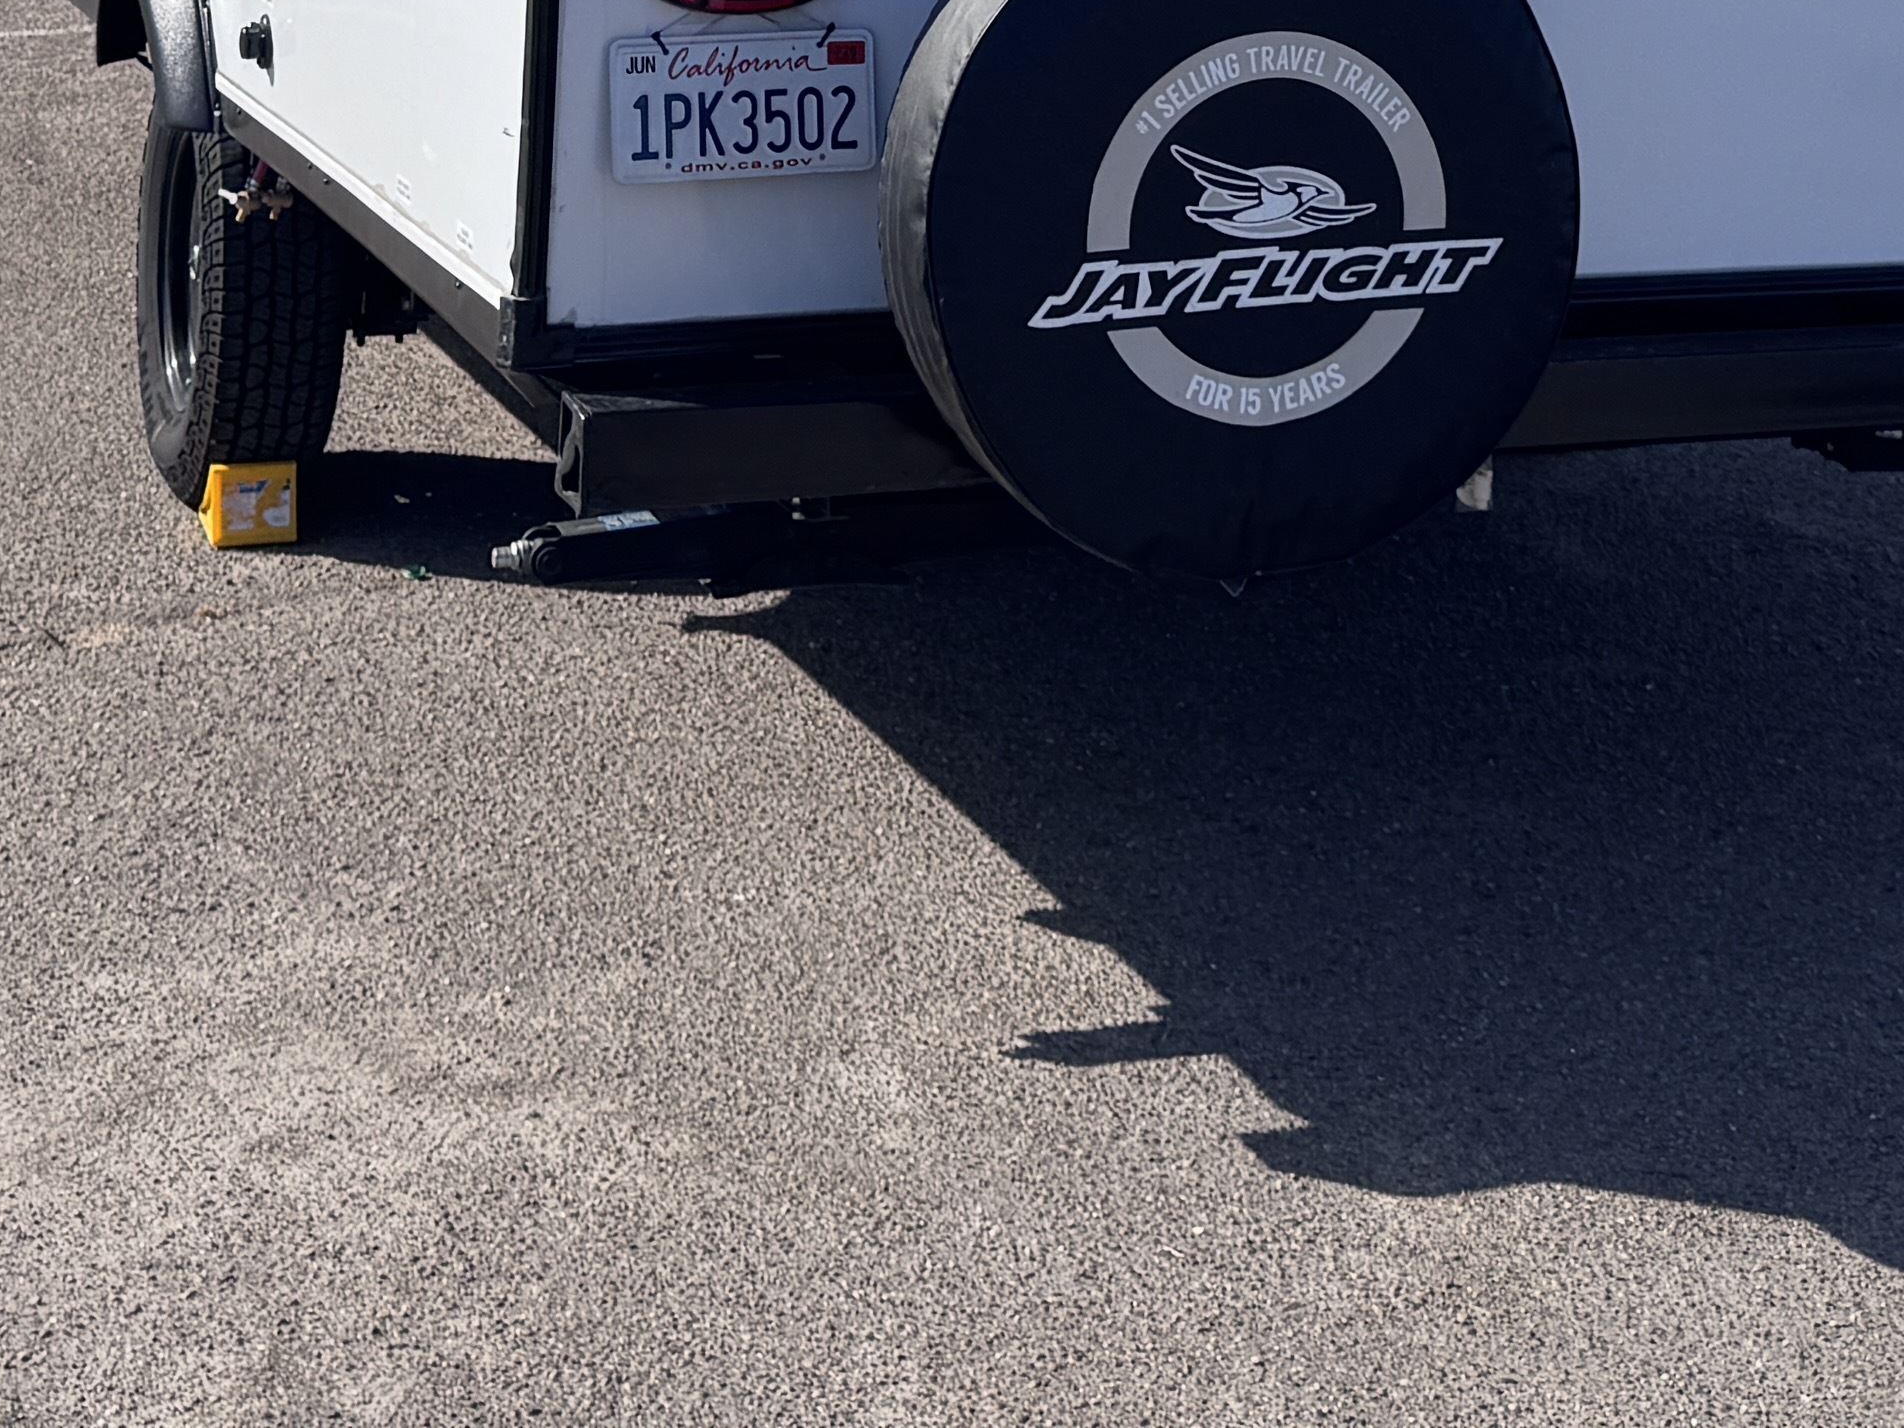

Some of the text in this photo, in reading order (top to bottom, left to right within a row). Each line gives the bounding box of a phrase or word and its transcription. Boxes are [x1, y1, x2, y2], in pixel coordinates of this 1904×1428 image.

[625, 55, 656, 75] JUN
[667, 45, 828, 87] California
[1135, 44, 1411, 135] #1 SELLING TRAVEL TRAILER
[631, 85, 859, 162] 1PK3502
[680, 156, 813, 174] dmv.ca.gov
[1185, 362, 1346, 416] FOR 15 YEARS
